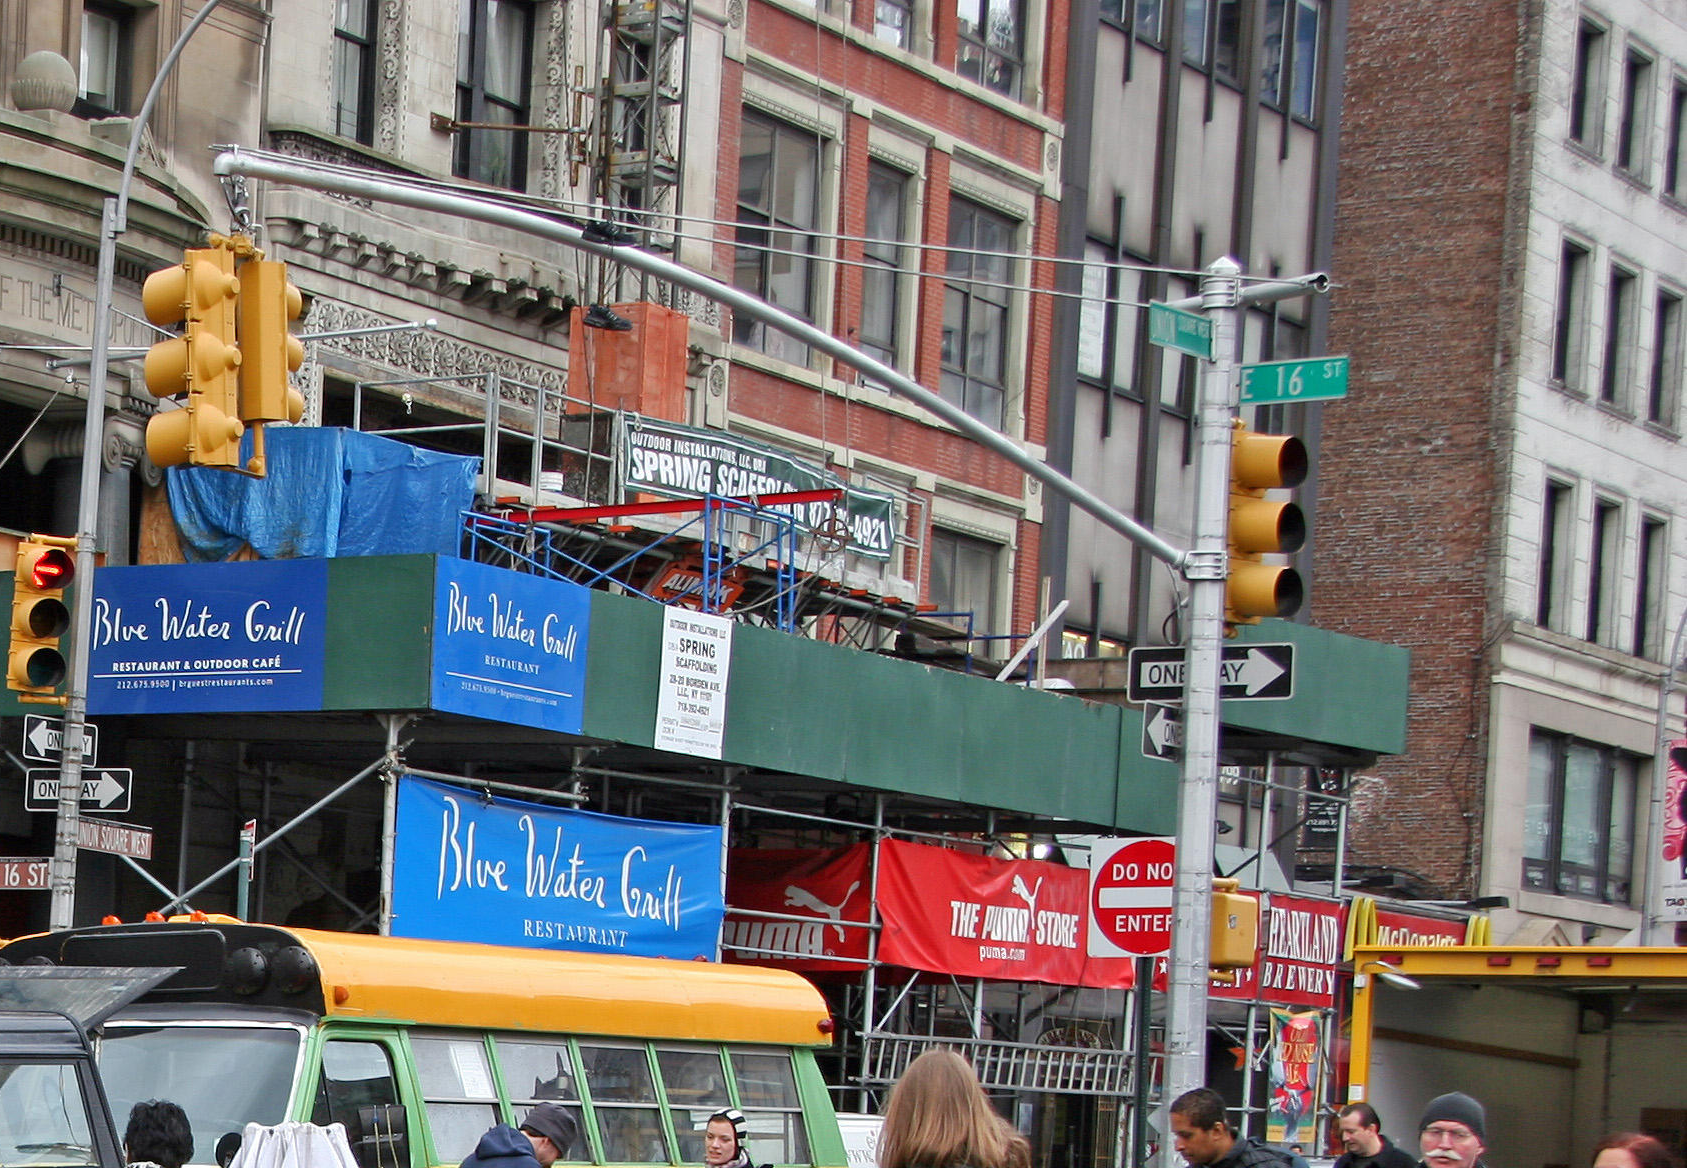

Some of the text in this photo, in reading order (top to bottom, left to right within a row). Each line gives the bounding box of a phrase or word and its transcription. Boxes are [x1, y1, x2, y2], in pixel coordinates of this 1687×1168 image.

[17, 279, 54, 323] THE
[1241, 361, 1343, 399] E 16 ST
[630, 431, 672, 452] OUTDOOR
[631, 447, 712, 493] SPRING
[93, 597, 306, 650] Blue Water Grill
[446, 581, 578, 663] Blue Water Grill
[112, 655, 281, 672] RESTAURANT & OUTDOOR CAFÉ
[679, 637, 716, 659] SPRING
[484, 653, 540, 676] RESTAURANT
[675, 656, 717, 675] SCAFFOLDING
[1148, 662, 1245, 684] ONE AY
[38, 781, 99, 798] ON AY
[3, 864, 20, 887] 16
[27, 863, 49, 886] ST
[437, 795, 683, 932] Blue Water Grill
[1112, 863, 1173, 881] DO NO
[523, 918, 629, 949] RESTAURANT
[721, 921, 824, 960] PUMA
[950, 901, 1079, 949] THE PUMA STORE
[1267, 905, 1338, 965] HEARTLAND
[979, 944, 1026, 962] puma.com
[1262, 961, 1335, 995] BREWERY
